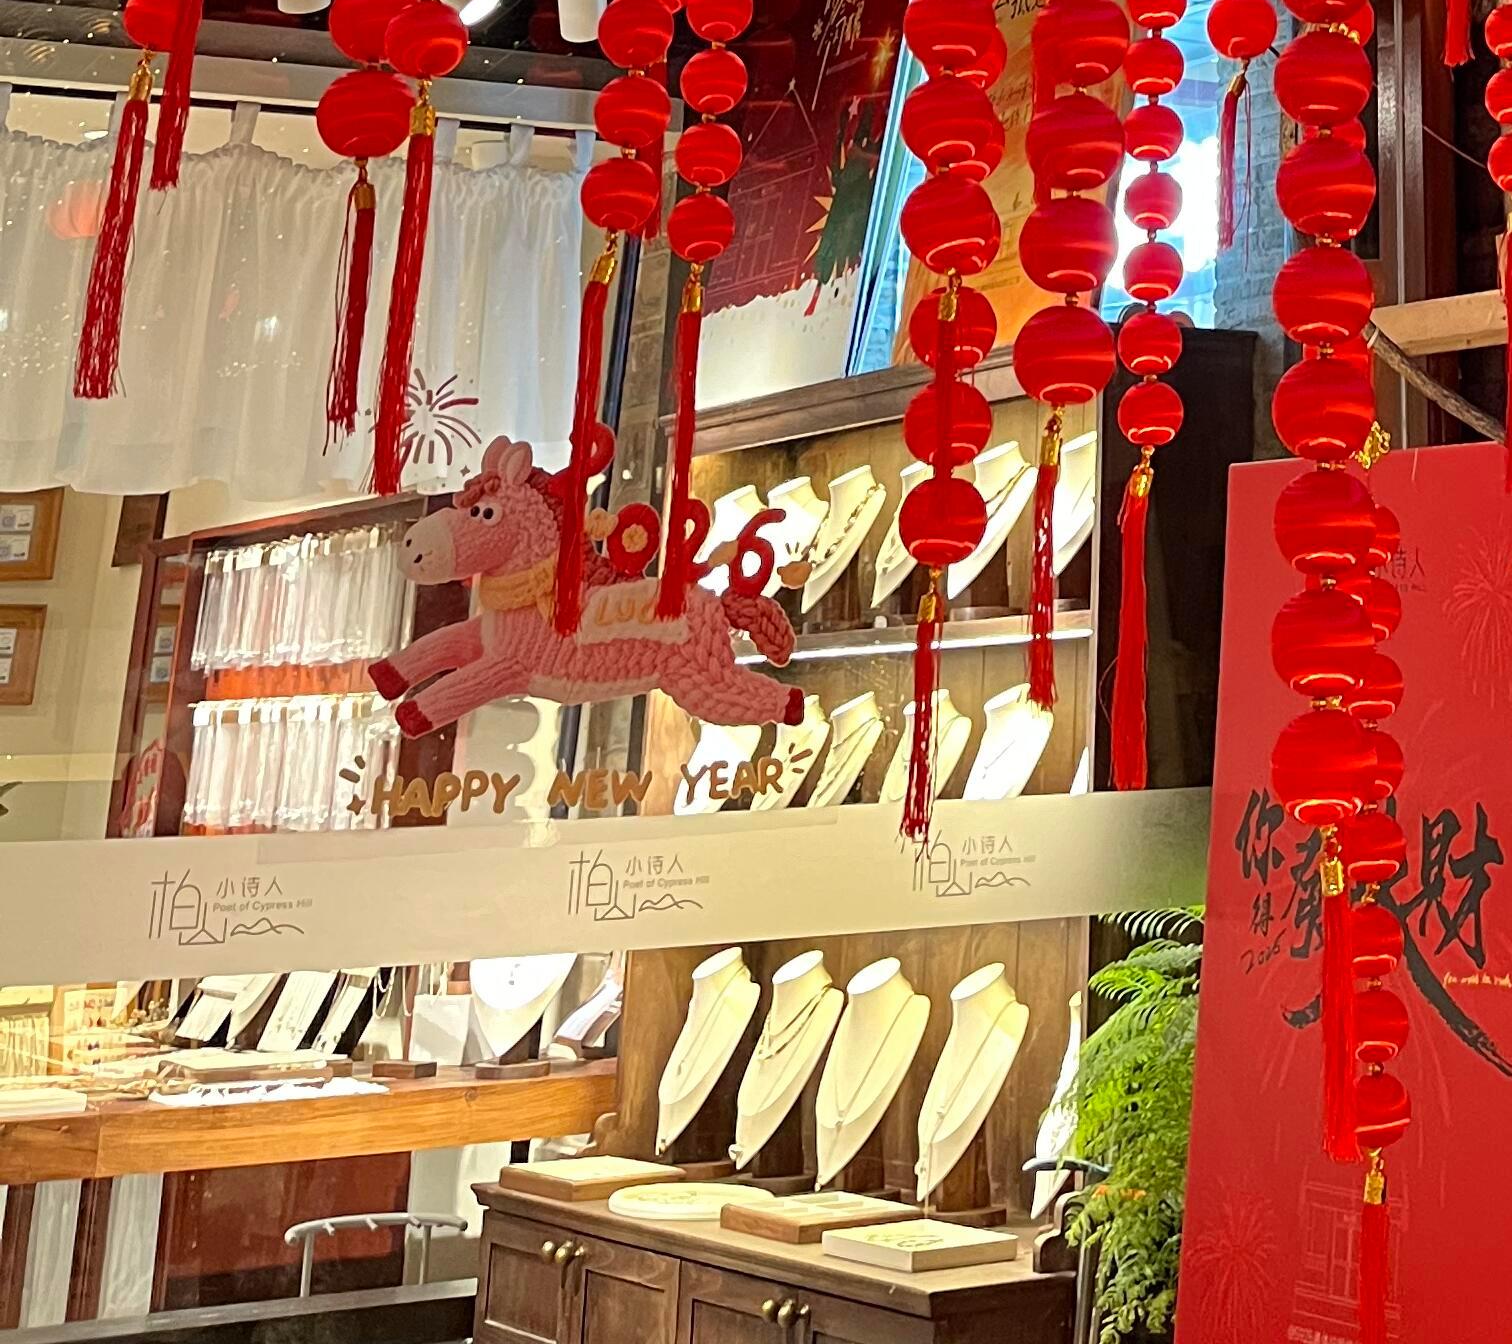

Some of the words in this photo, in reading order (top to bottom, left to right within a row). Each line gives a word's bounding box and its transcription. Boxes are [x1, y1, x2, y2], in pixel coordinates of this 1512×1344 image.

[371, 769, 521, 818] HAPPY
[547, 768, 653, 810] NEW
[680, 756, 784, 805] YEAR
[962, 834, 1013, 855] 小诗人
[625, 853, 684, 876] 小诗人
[216, 875, 283, 900] 小诗人
[213, 902, 236, 913] Poet
[239, 901, 250, 911] of
[252, 900, 293, 913] Cypress
